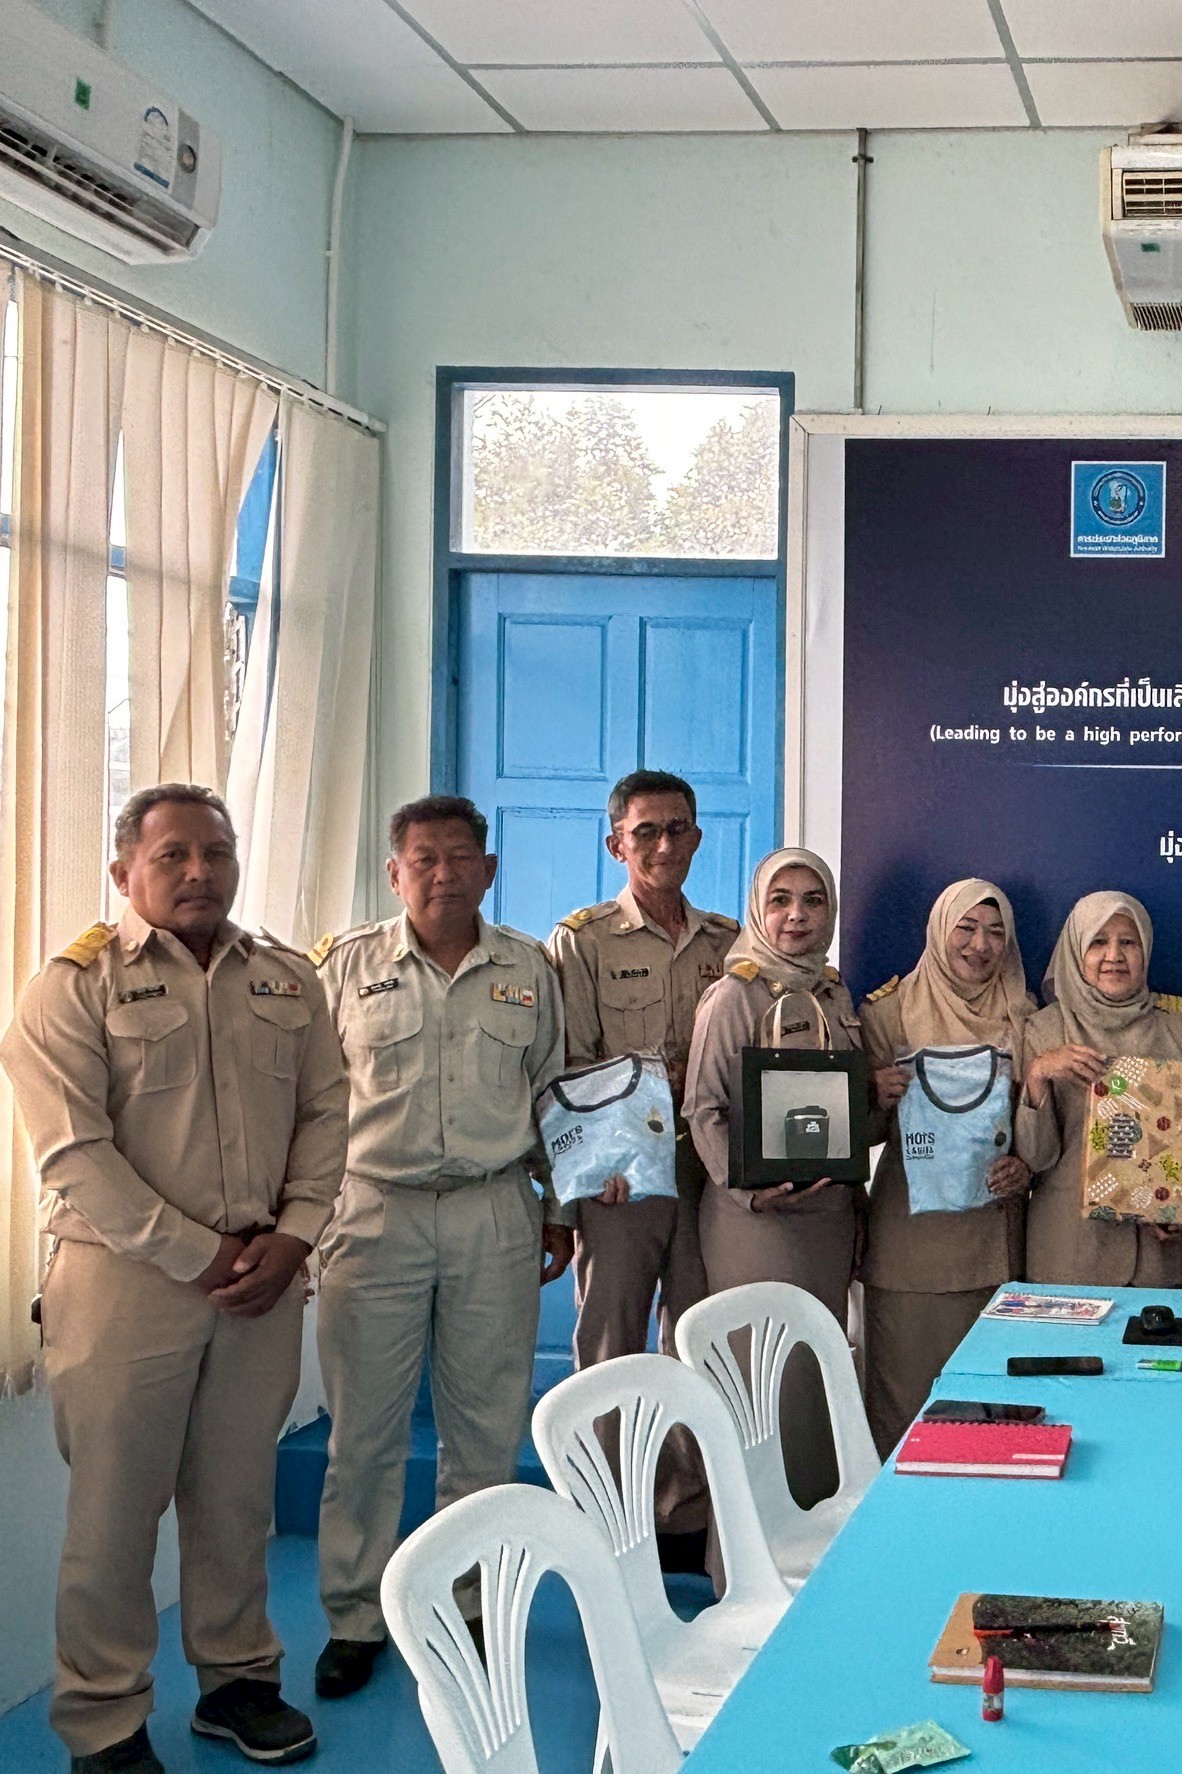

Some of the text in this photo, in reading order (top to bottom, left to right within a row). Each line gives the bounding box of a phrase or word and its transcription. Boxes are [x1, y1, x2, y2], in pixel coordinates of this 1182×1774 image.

[930, 725, 1002, 746] (Leading
[1009, 727, 1028, 742] to
[1036, 726, 1057, 743] be
[1065, 730, 1076, 743] a
[1084, 726, 1122, 747] high
